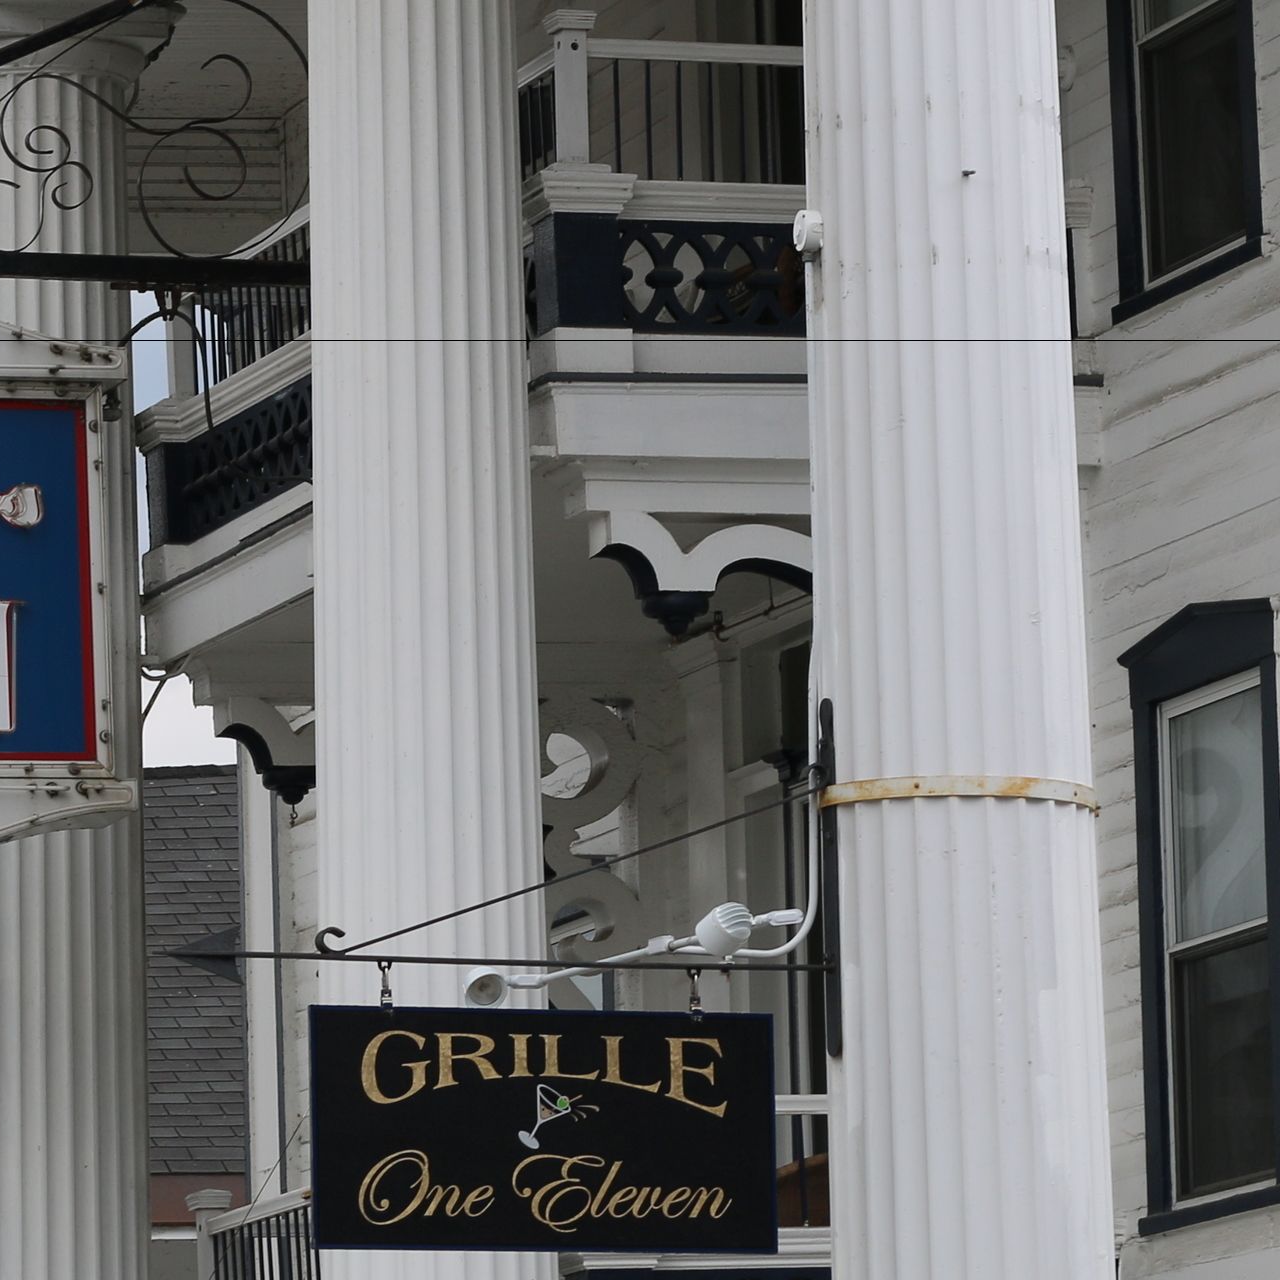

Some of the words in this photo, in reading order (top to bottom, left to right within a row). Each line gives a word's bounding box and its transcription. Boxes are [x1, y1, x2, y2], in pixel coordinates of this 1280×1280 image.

[360, 1029, 728, 1118] GRILLE
[357, 1149, 495, 1226] One
[512, 1153, 733, 1233] Eleven
